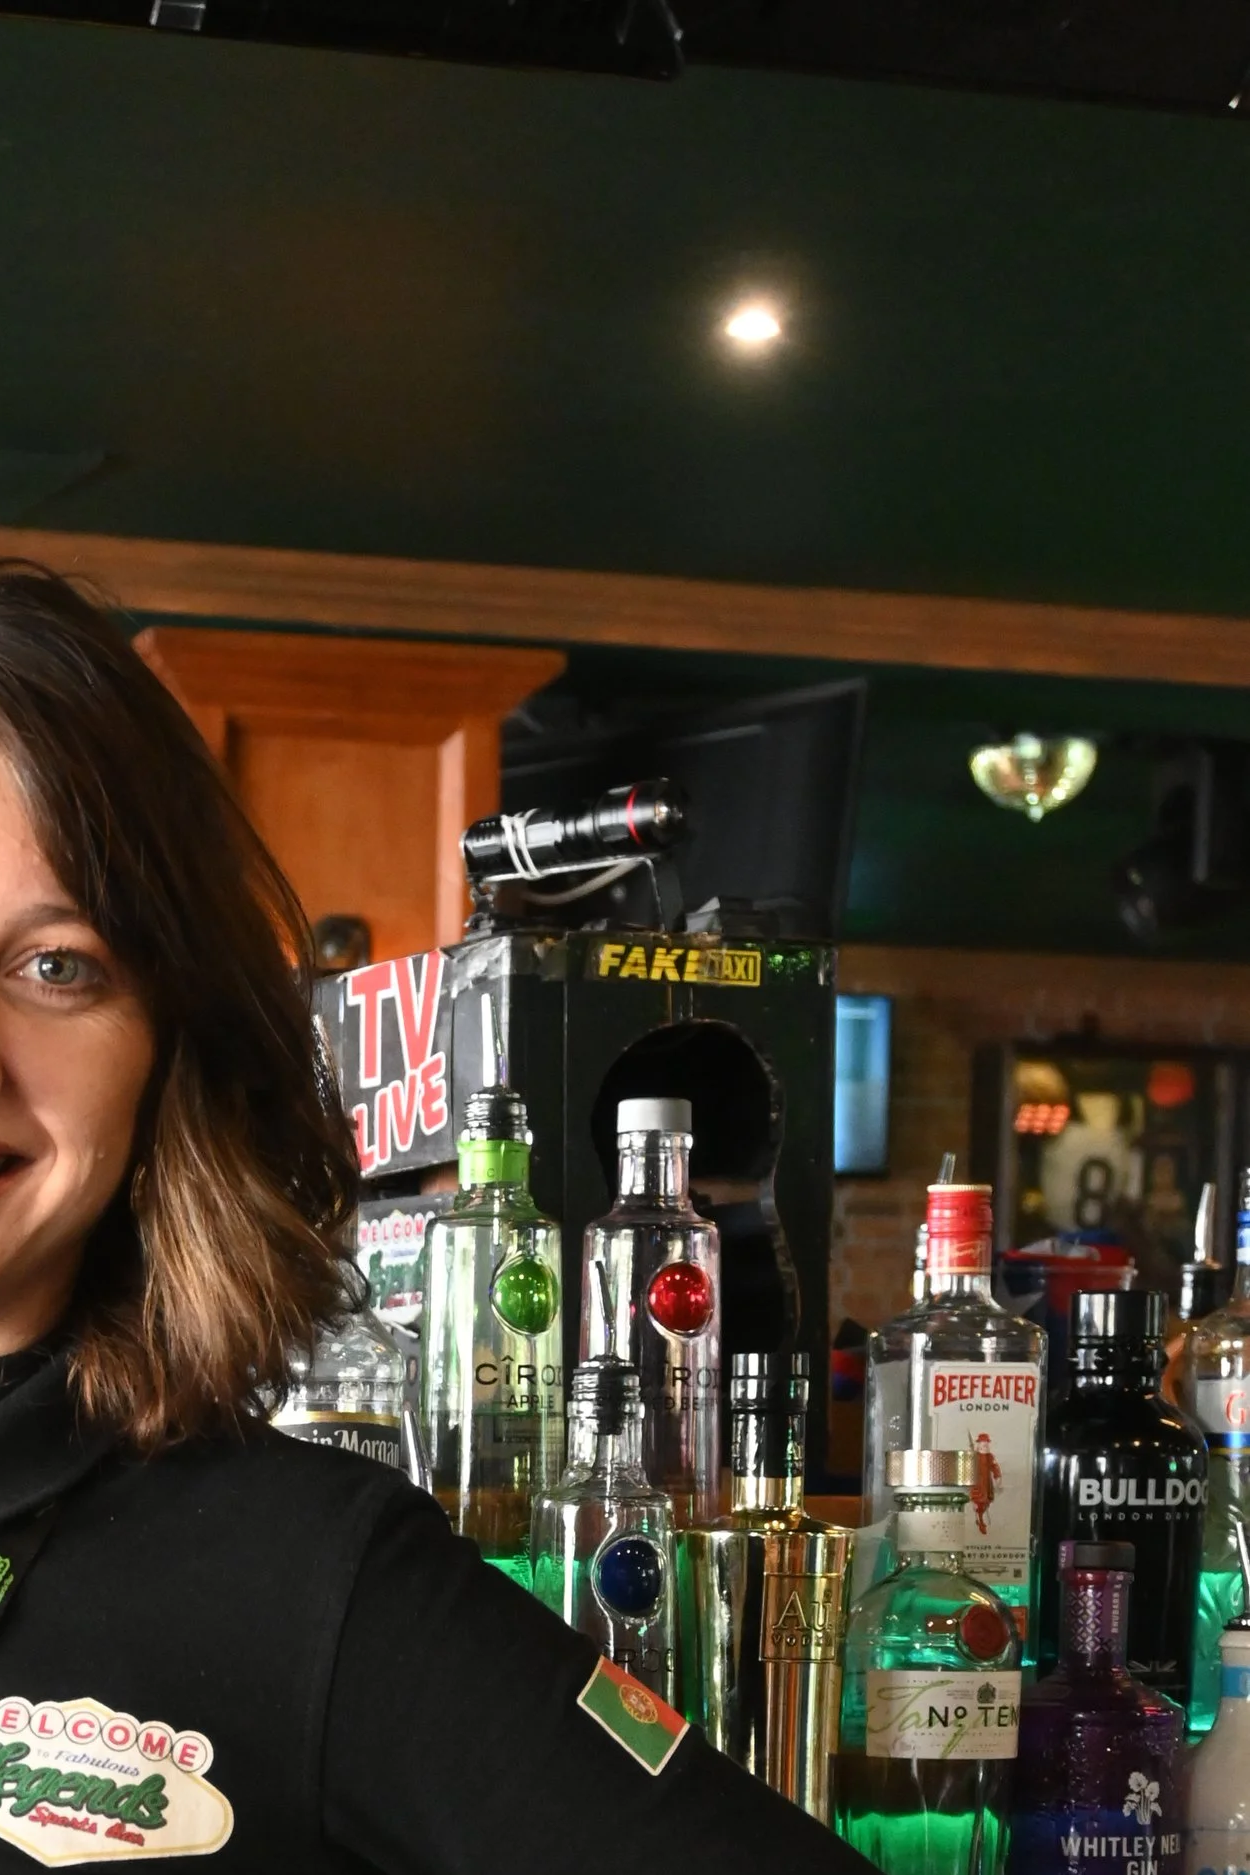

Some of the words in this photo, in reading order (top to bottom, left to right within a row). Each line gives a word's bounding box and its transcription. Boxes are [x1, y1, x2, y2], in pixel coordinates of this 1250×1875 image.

[350, 950, 442, 1085] TV
[352, 1052, 447, 1175] LIVE
[359, 1219, 426, 1241] WELCOM
[507, 1394, 554, 1410] APPLE
[934, 1373, 1036, 1408] BEEFEATER
[960, 1403, 1010, 1413] LONDON
[1078, 1511, 1154, 1521] LONDON
[772, 1591, 832, 1632] Au
[54, 1750, 141, 1777] Fabulous
[28, 1805, 98, 1835] Sports
[1061, 1834, 1156, 1858] WHITLEY
